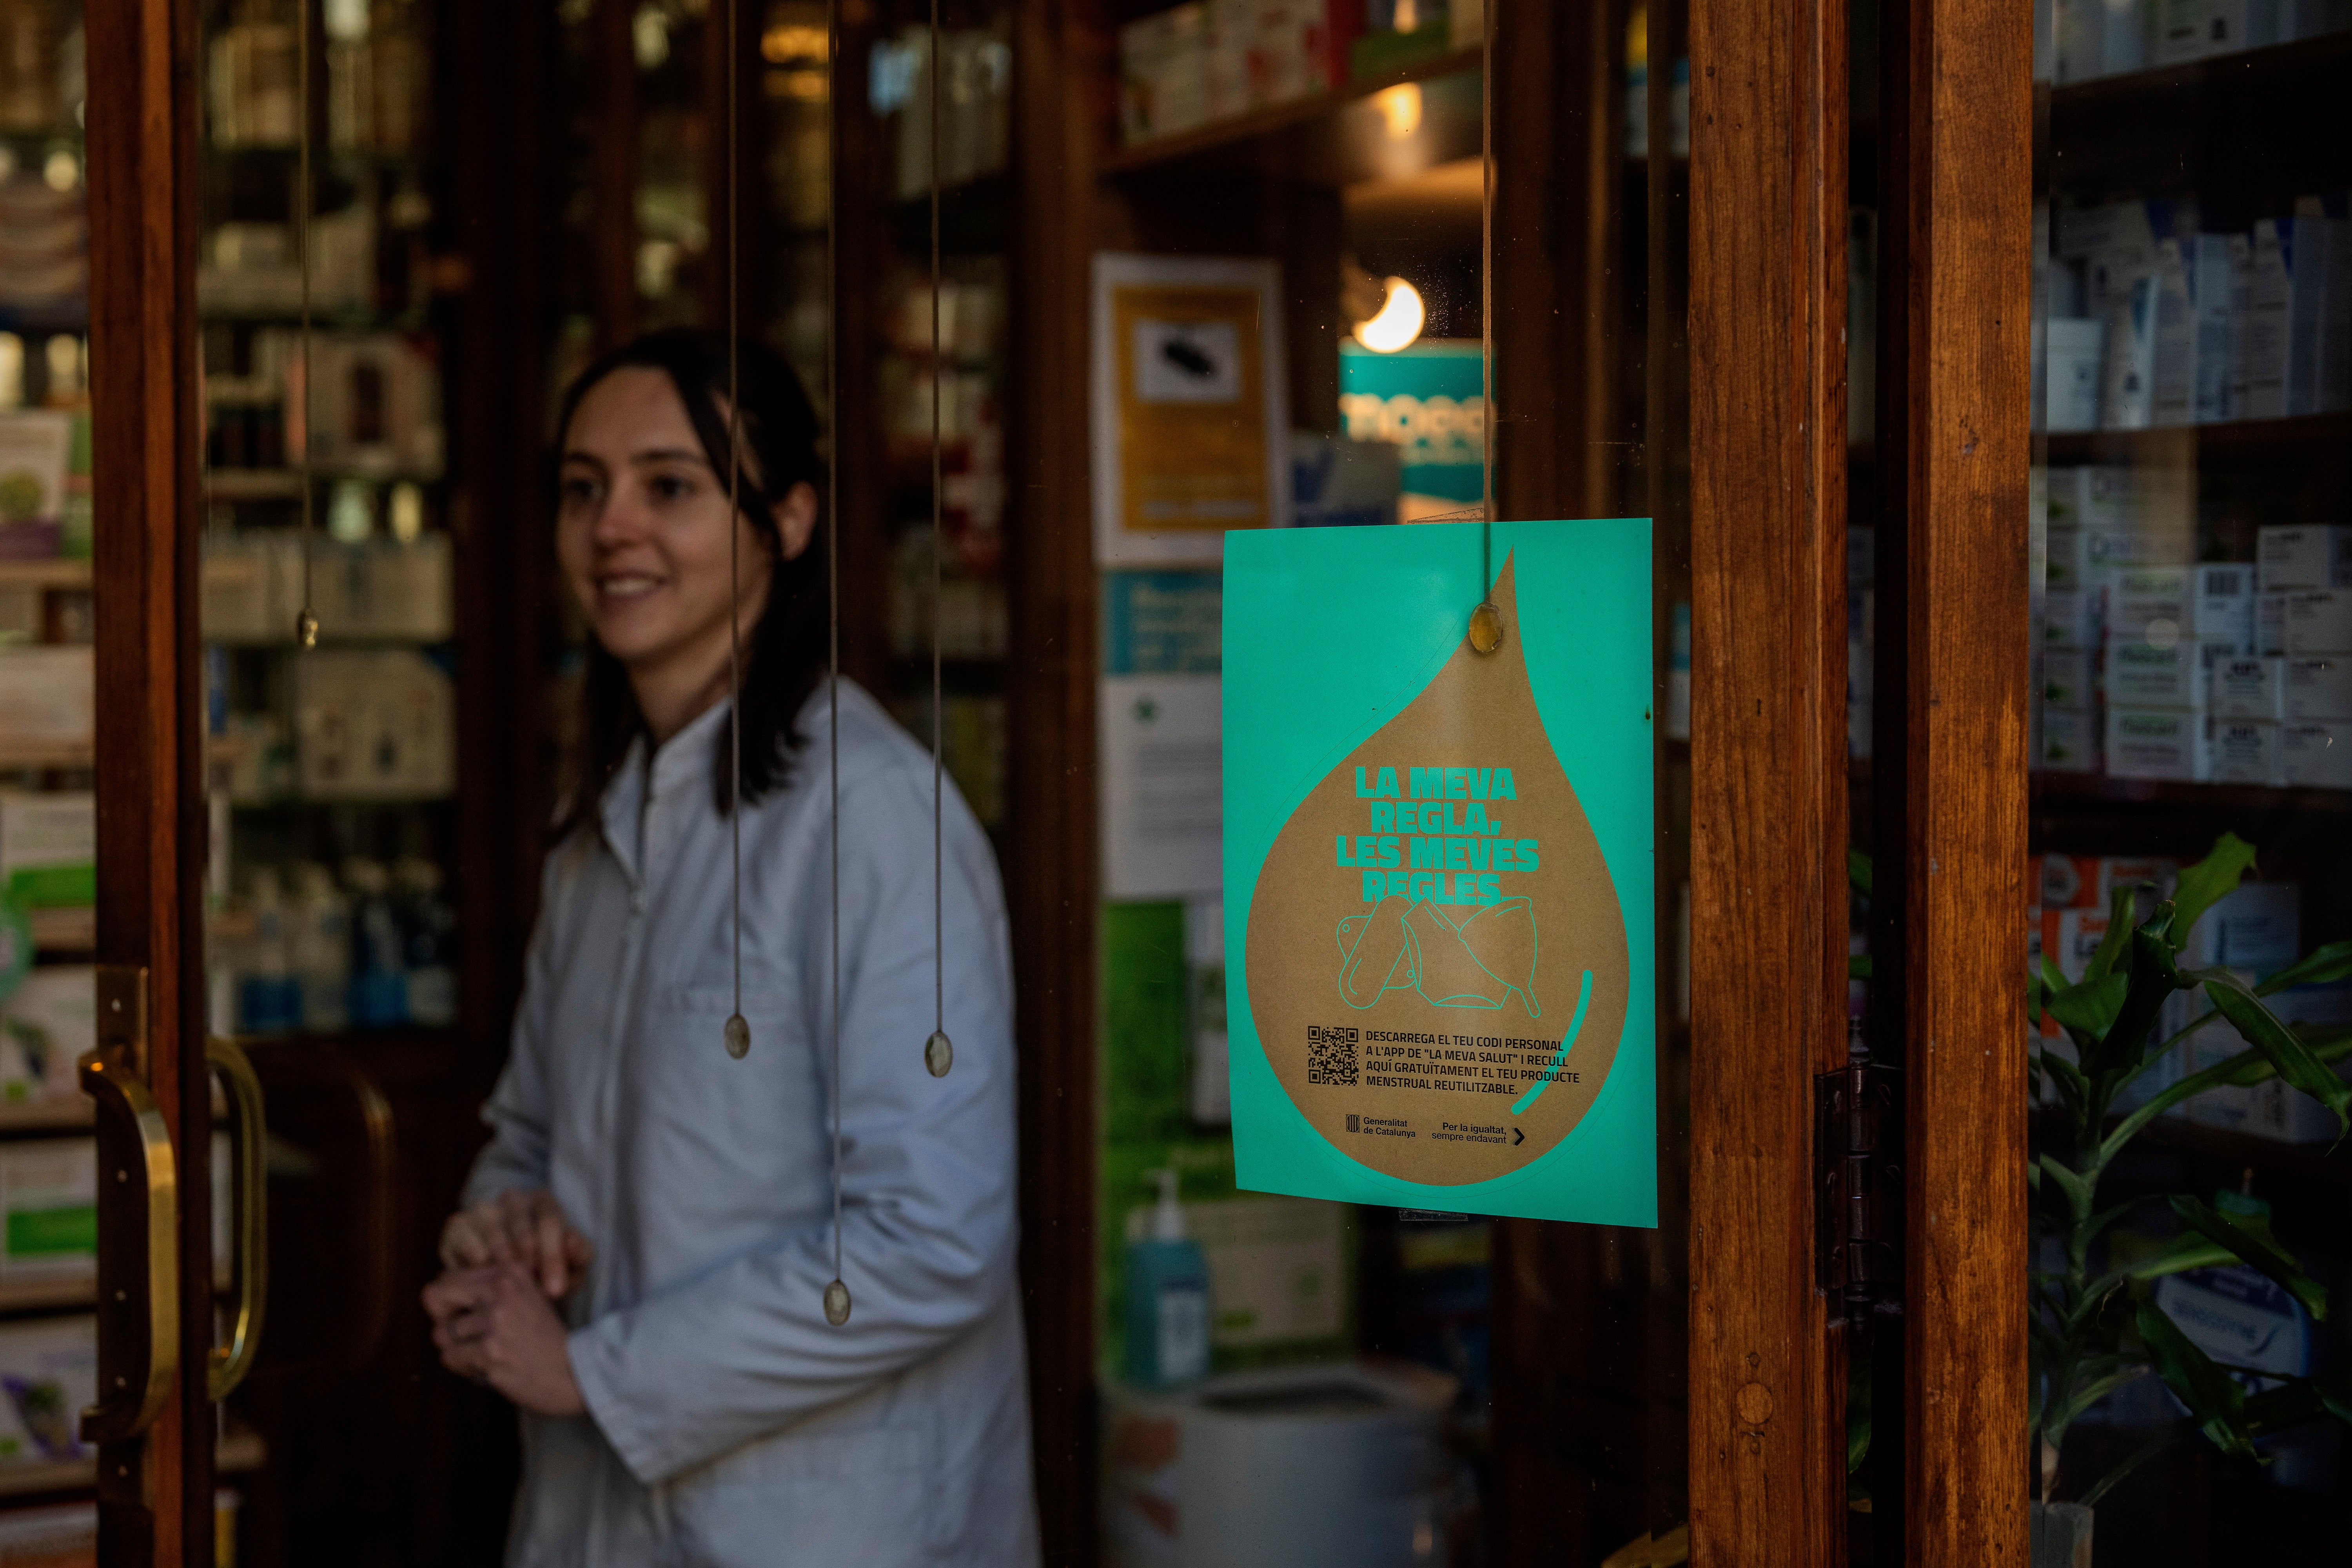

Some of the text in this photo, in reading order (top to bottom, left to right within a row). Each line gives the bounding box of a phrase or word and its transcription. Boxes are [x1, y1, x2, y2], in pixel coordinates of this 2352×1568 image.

[1356, 766, 1517, 800] LA MEVA
[1371, 801, 1501, 835] REGLA,
[1336, 835, 1539, 872] LES MEVES
[1366, 1031, 1563, 1051] DESCARREGA EL TEU CODI PERSONAL
[1366, 1046, 1568, 1067] A L'APP DE "LA MEVA SALUT" I RECULL
[1366, 1059, 1579, 1083] AQUÍ GRATUÏTAMENT EL TEU PRODUCTE
[1367, 1076, 1518, 1094] MENSTRUAL REUTILITZABLE.
[1363, 1116, 1408, 1127] Generalitat
[1443, 1122, 1506, 1135] Per la igualtat,
[1376, 1127, 1416, 1139] Catalunya
[1432, 1131, 1506, 1143] sempre endavant
